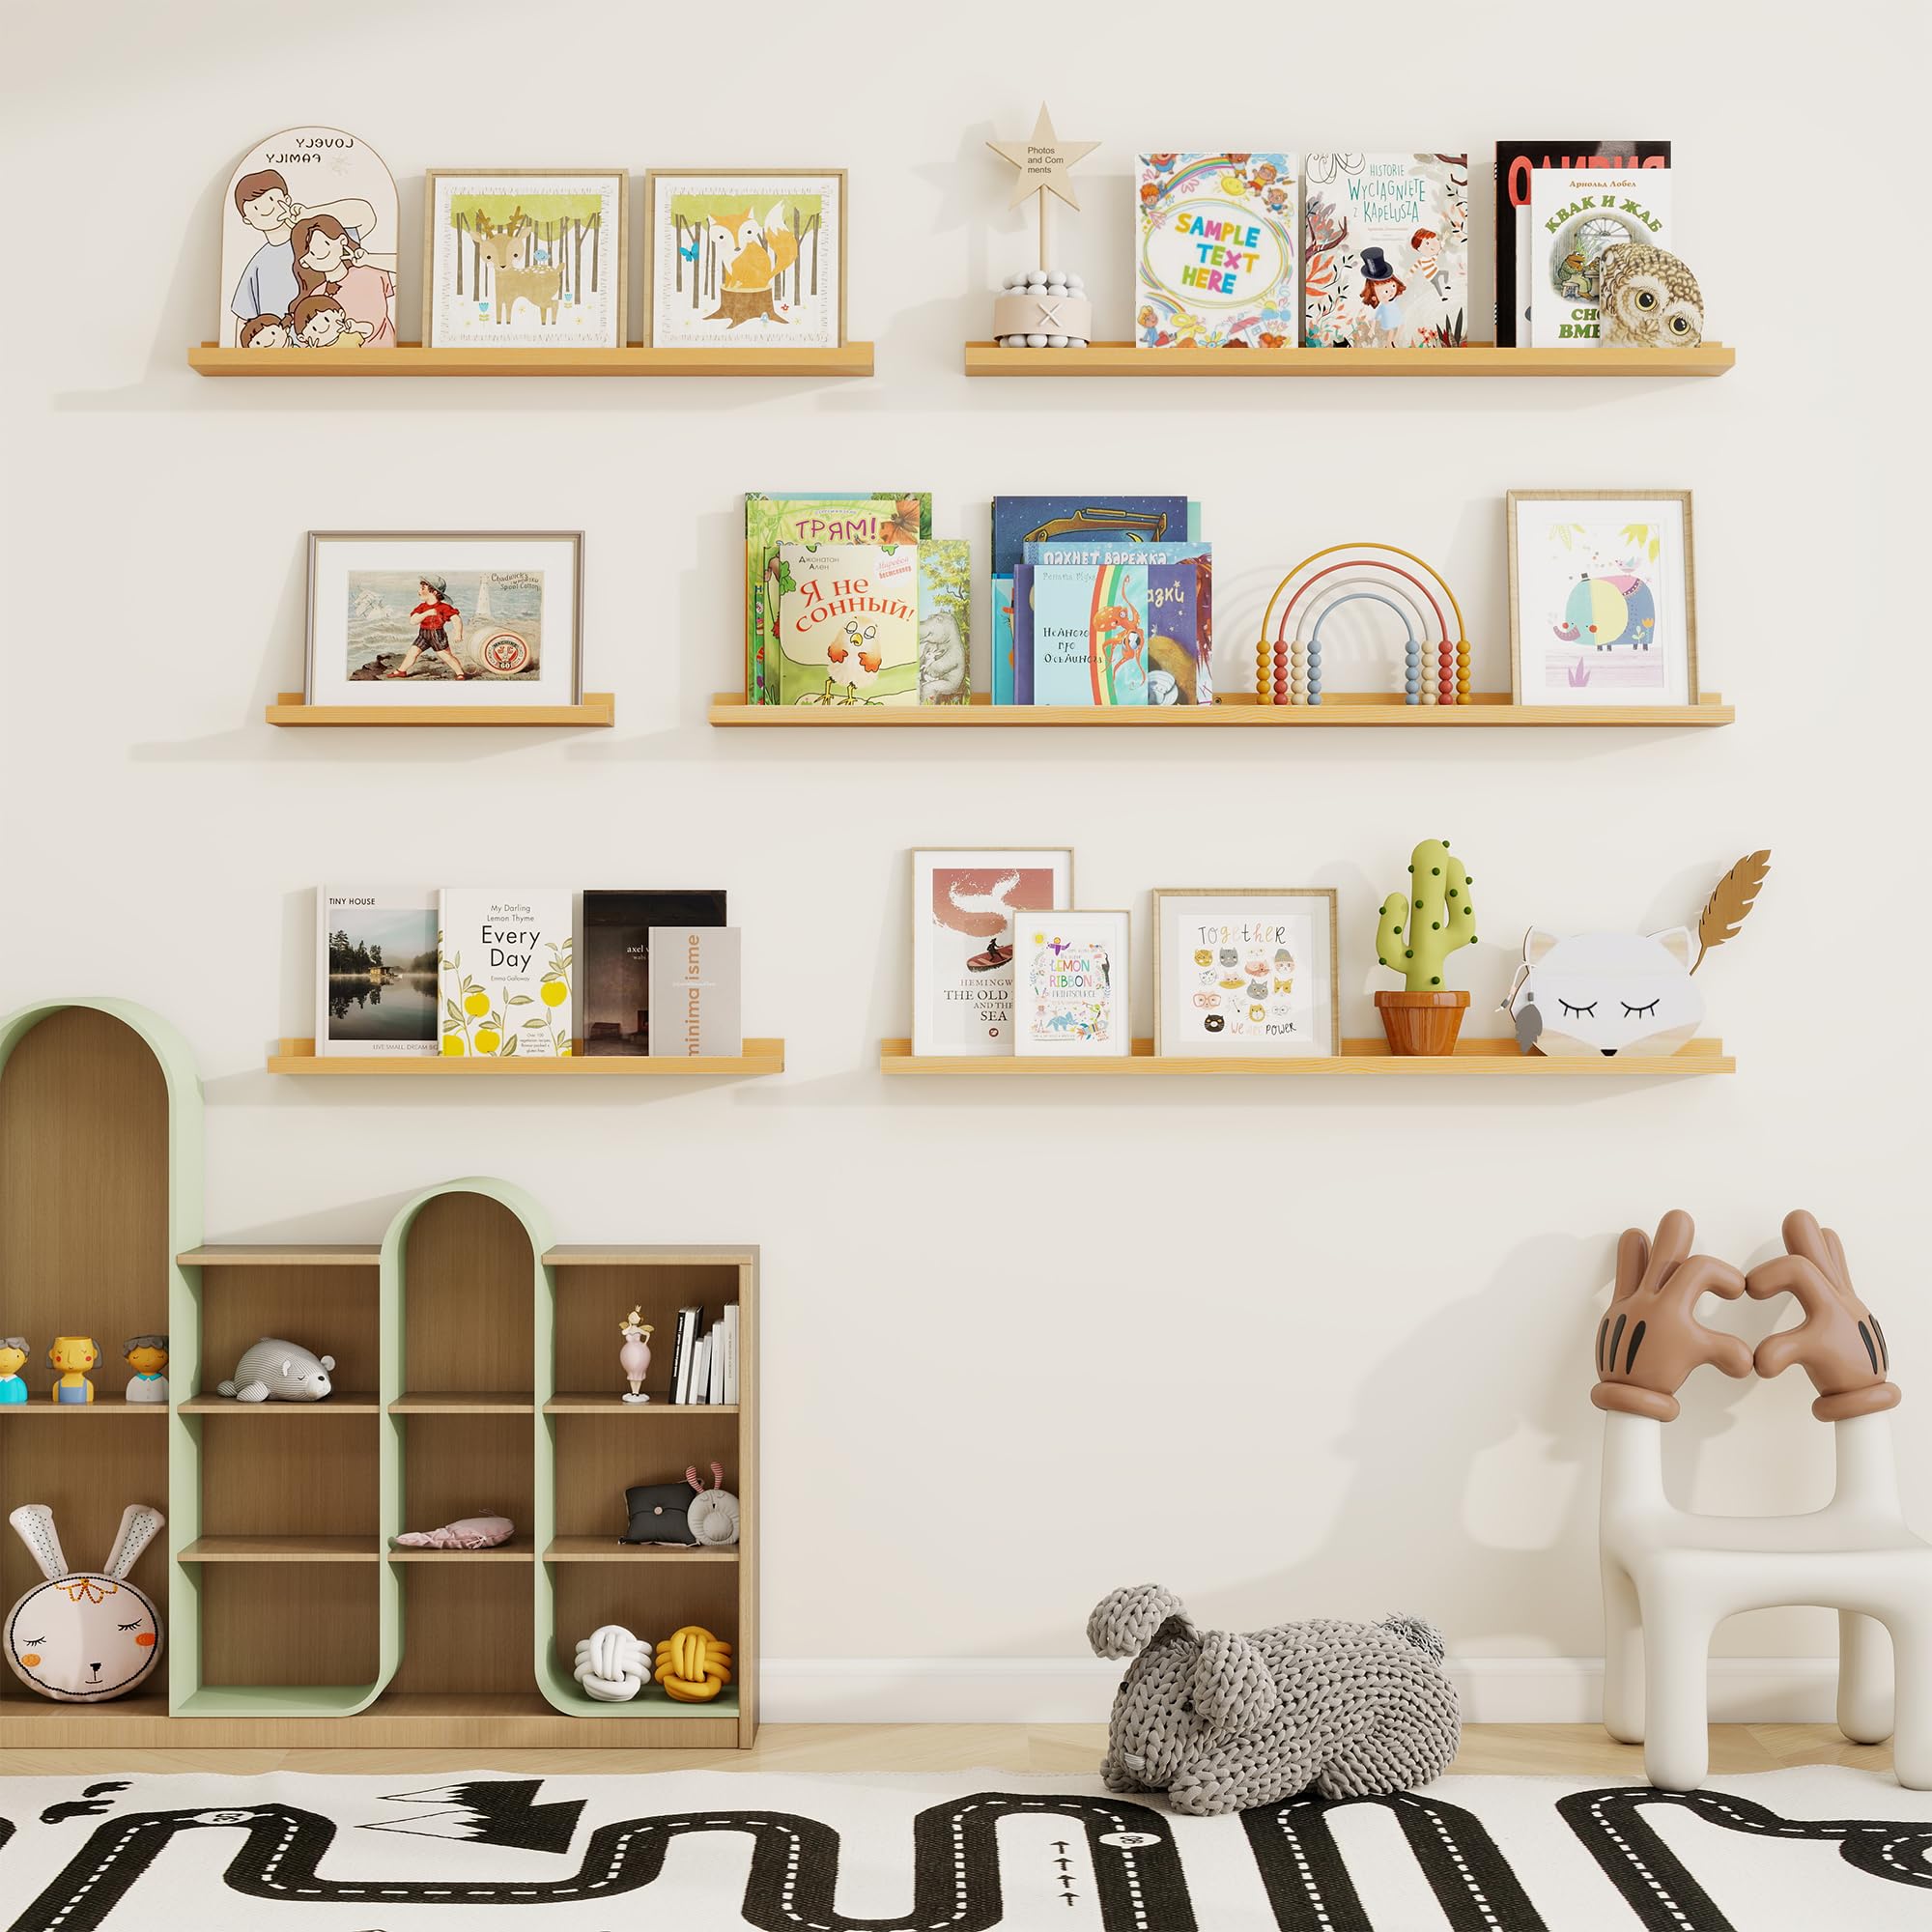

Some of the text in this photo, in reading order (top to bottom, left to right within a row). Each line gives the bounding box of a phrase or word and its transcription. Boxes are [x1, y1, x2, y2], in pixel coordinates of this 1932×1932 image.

[1027, 146, 1056, 155] Photos
[1027, 156, 1065, 164] and Com
[1370, 163, 1405, 177] HISTORIE
[1363, 200, 1420, 223] KAPELUSZA
[1545, 195, 1663, 234] КВАК И ЖАБ
[1175, 213, 1261, 248] SAMPLE
[1196, 243, 1260, 274] TEXT
[1181, 265, 1237, 295] HERE
[1571, 308, 1601, 321] СН
[795, 517, 876, 541] ТРЯМ!
[800, 579, 869, 609] Я не
[1148, 586, 1184, 609] азки
[795, 596, 916, 633] сонный!
[491, 904, 531, 914] My Darling
[512, 914, 534, 923] Thyme
[482, 924, 541, 951] Every
[626, 944, 644, 953] axel
[491, 948, 532, 973] Day
[1050, 959, 1091, 973] LEMON
[1049, 975, 1093, 988] RIBBON
[943, 990, 975, 1001] THE
[977, 989, 1009, 1001] OLD
[980, 1010, 1008, 1022] SEA
